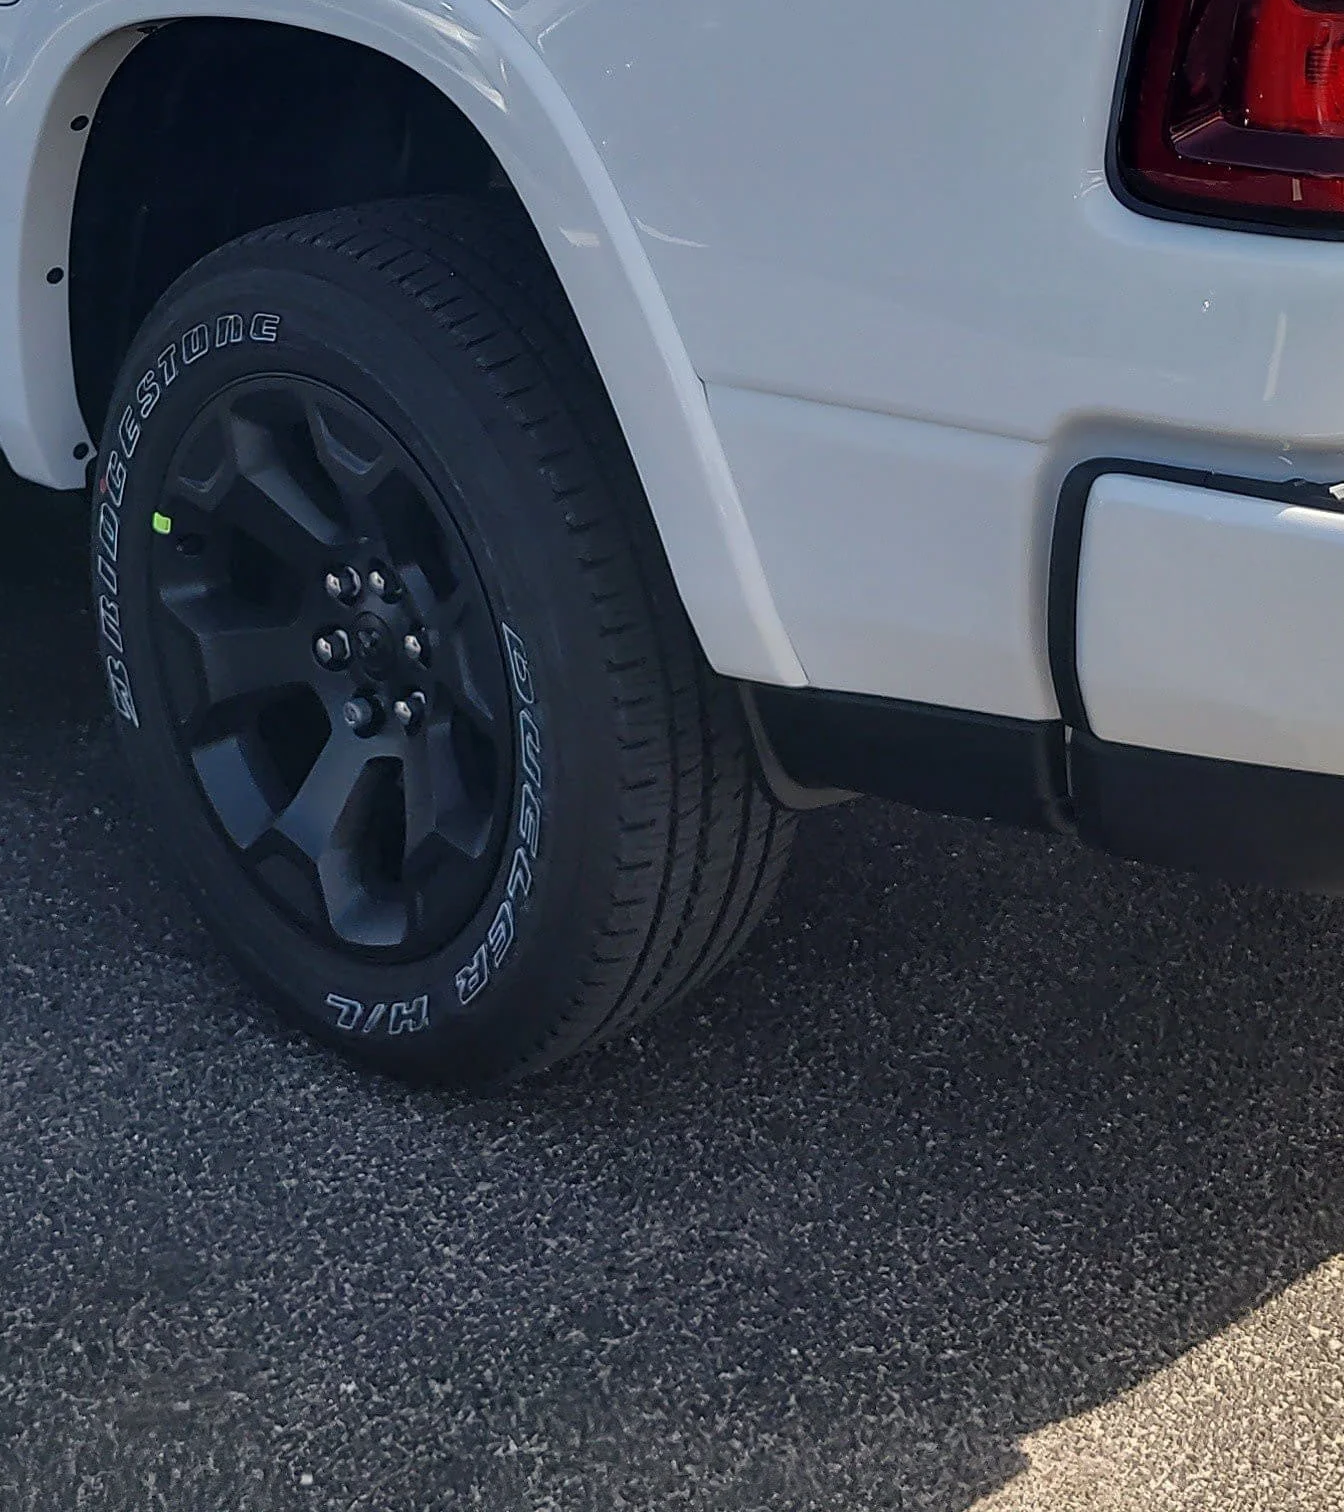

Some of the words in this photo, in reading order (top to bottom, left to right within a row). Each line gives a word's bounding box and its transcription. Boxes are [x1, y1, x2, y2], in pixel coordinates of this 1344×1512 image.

[97, 312, 280, 728] BRIDGESTONE
[455, 621, 544, 1006] DUELER
[326, 993, 431, 1036] H/L
